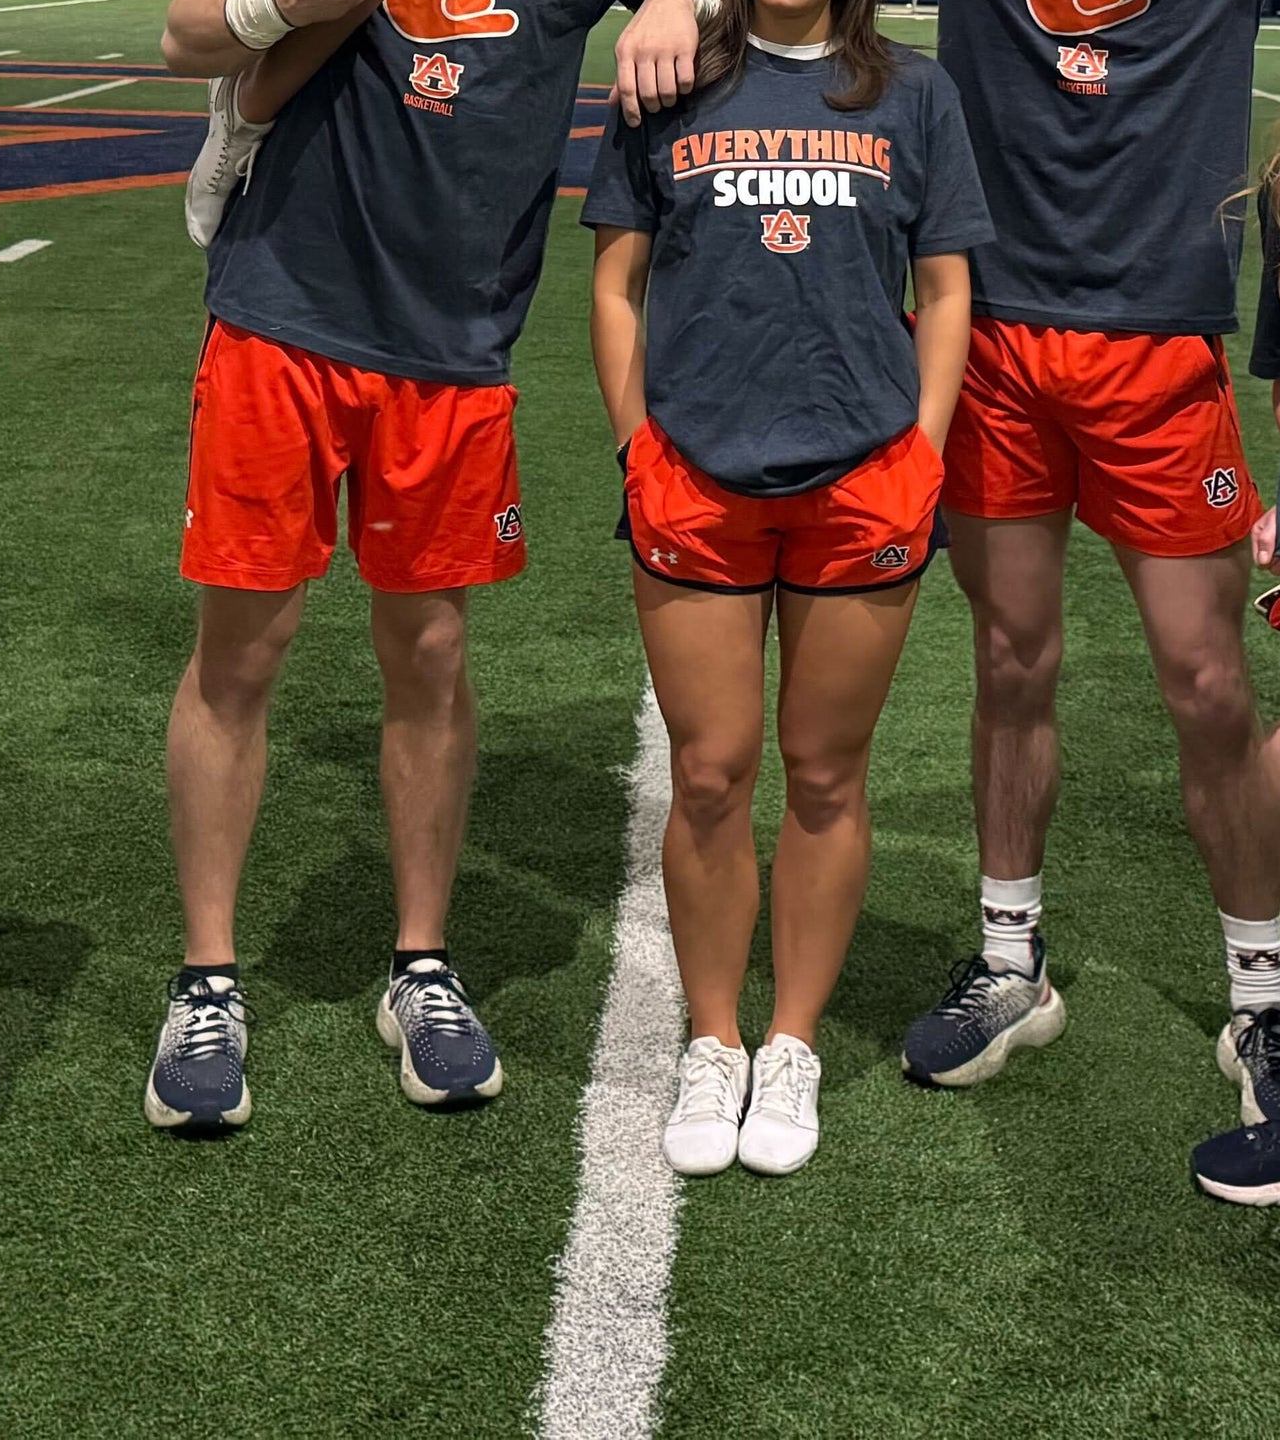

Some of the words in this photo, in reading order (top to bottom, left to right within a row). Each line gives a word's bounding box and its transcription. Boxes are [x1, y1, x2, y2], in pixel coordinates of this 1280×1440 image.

[403, 93, 454, 117] BASKETBALL
[672, 129, 891, 174] EVERYTHING
[712, 169, 857, 207] SCHOOL
